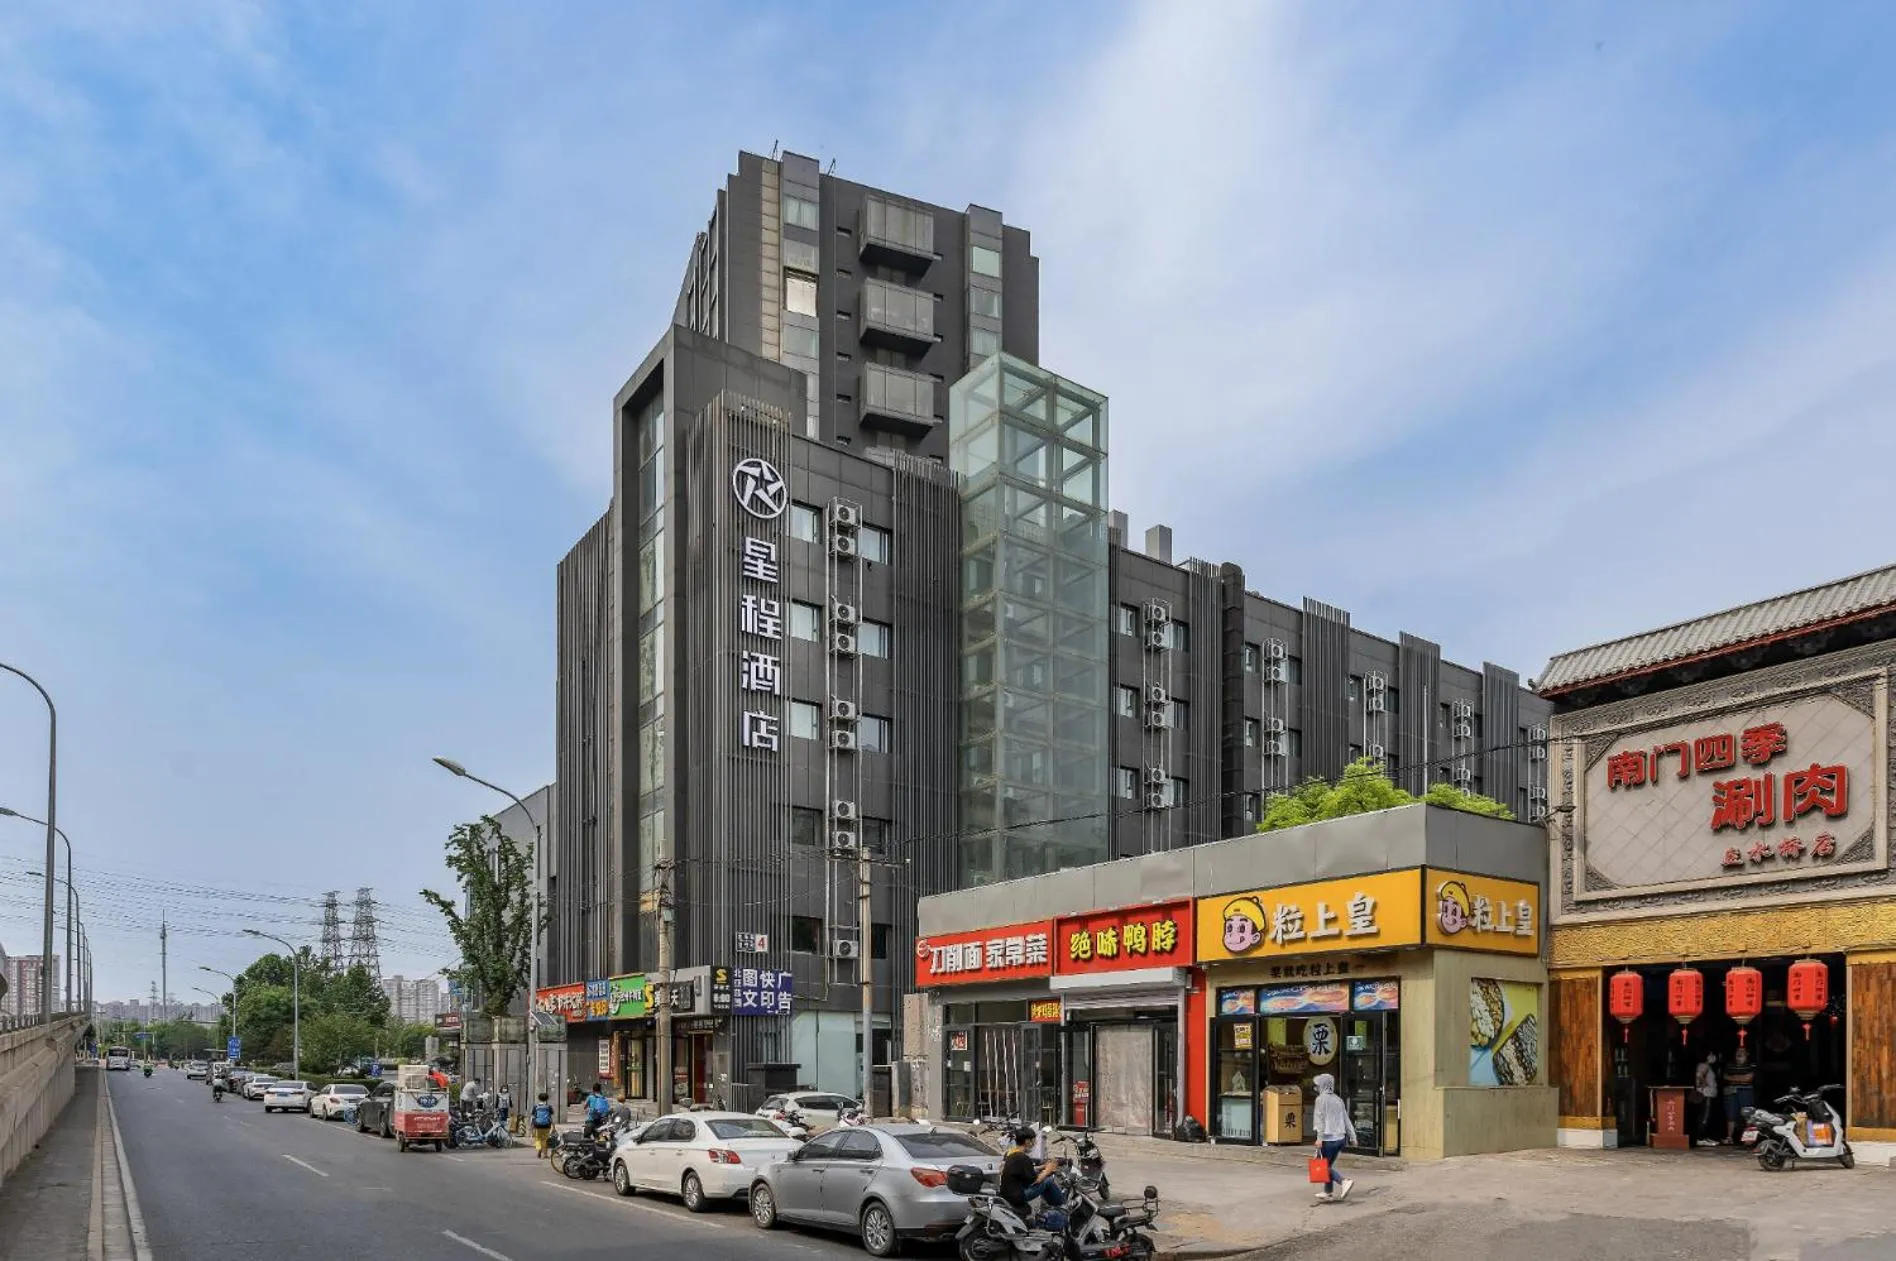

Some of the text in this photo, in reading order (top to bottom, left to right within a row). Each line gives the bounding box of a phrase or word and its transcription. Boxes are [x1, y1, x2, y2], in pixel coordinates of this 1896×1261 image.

[741, 536, 783, 752] 星程酒店
[1606, 721, 1788, 790] 南门四季
[1711, 762, 1849, 831] 涮肉
[1070, 920, 1177, 960] 绝味鸭脖
[1268, 891, 1381, 945] 粒上皇
[1469, 895, 1535, 937] 粒上皇
[929, 932, 1048, 974] 刀削面 家常菜
[1312, 1023, 1331, 1056] 栗
